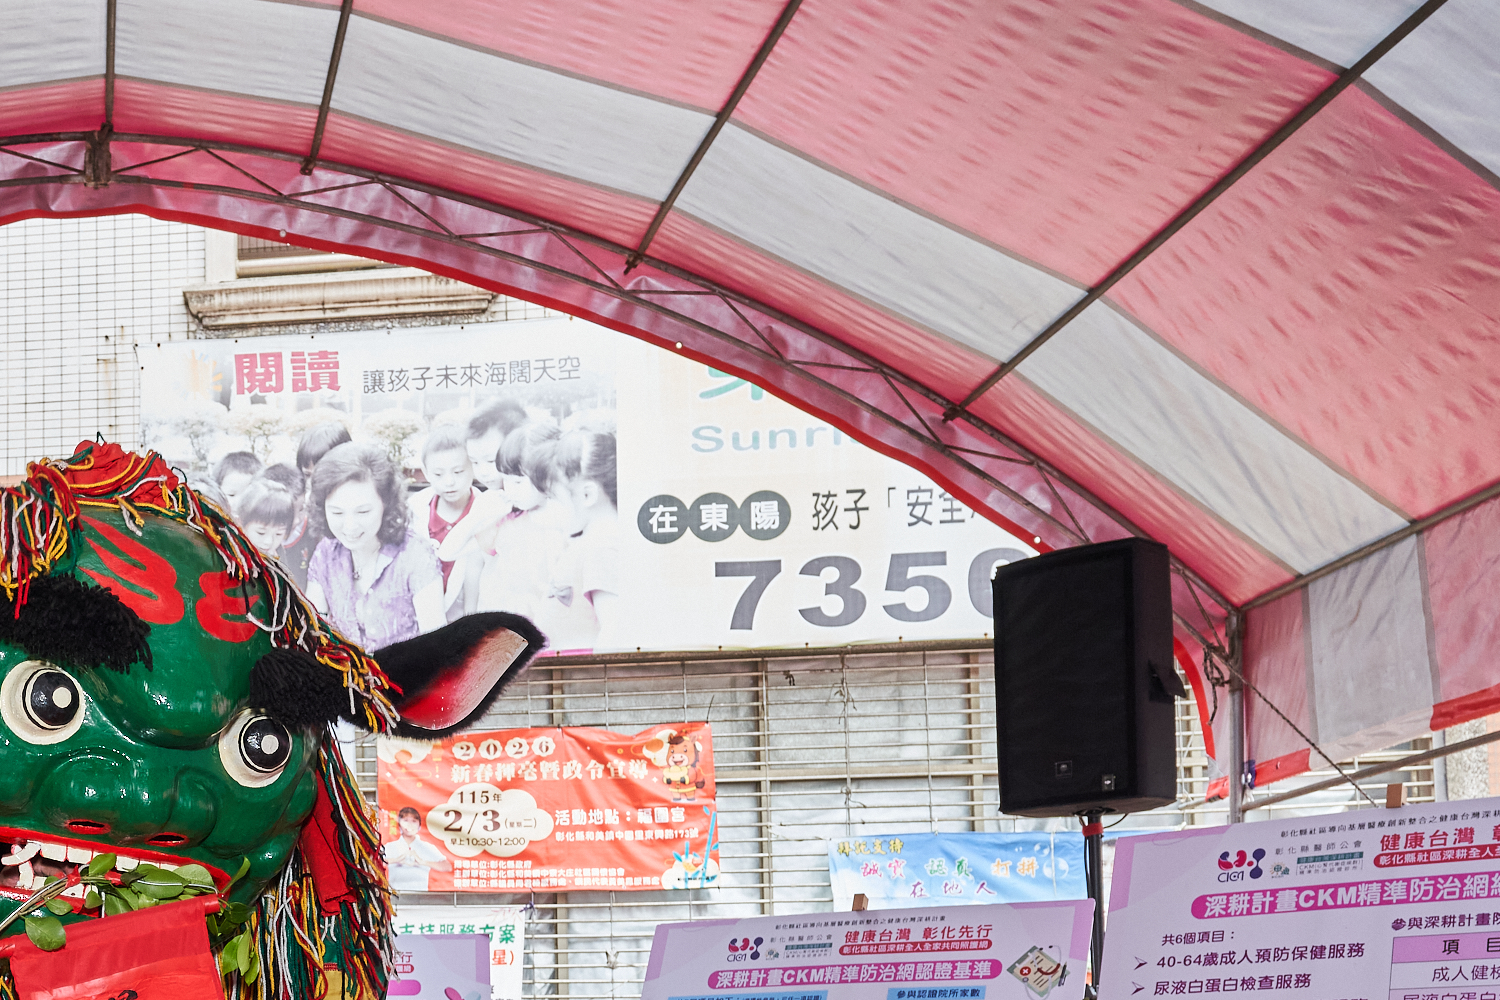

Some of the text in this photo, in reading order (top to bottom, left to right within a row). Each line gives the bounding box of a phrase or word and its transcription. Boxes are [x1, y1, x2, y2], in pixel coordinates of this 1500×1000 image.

[234, 350, 581, 395] 閱讀 讓孩子未來海闊天空
[691, 423, 858, 453] Sunri
[648, 500, 780, 534] 在東陽
[458, 739, 550, 757] 2026
[457, 790, 503, 804] 115年
[444, 809, 501, 835] 2/3
[1380, 826, 1475, 852] 健康台灣
[910, 881, 996, 898] 在地人
[844, 923, 994, 944] 健康台灣 彰化先行
[1156, 942, 1366, 969] 40-64歲成人預防保健服務
[715, 960, 992, 989] 深耕計畫CKM精準防治網認證基準
[1153, 972, 1312, 996] 尿液白蛋白檢查服務
[896, 988, 981, 999] 參與認證院所家數
